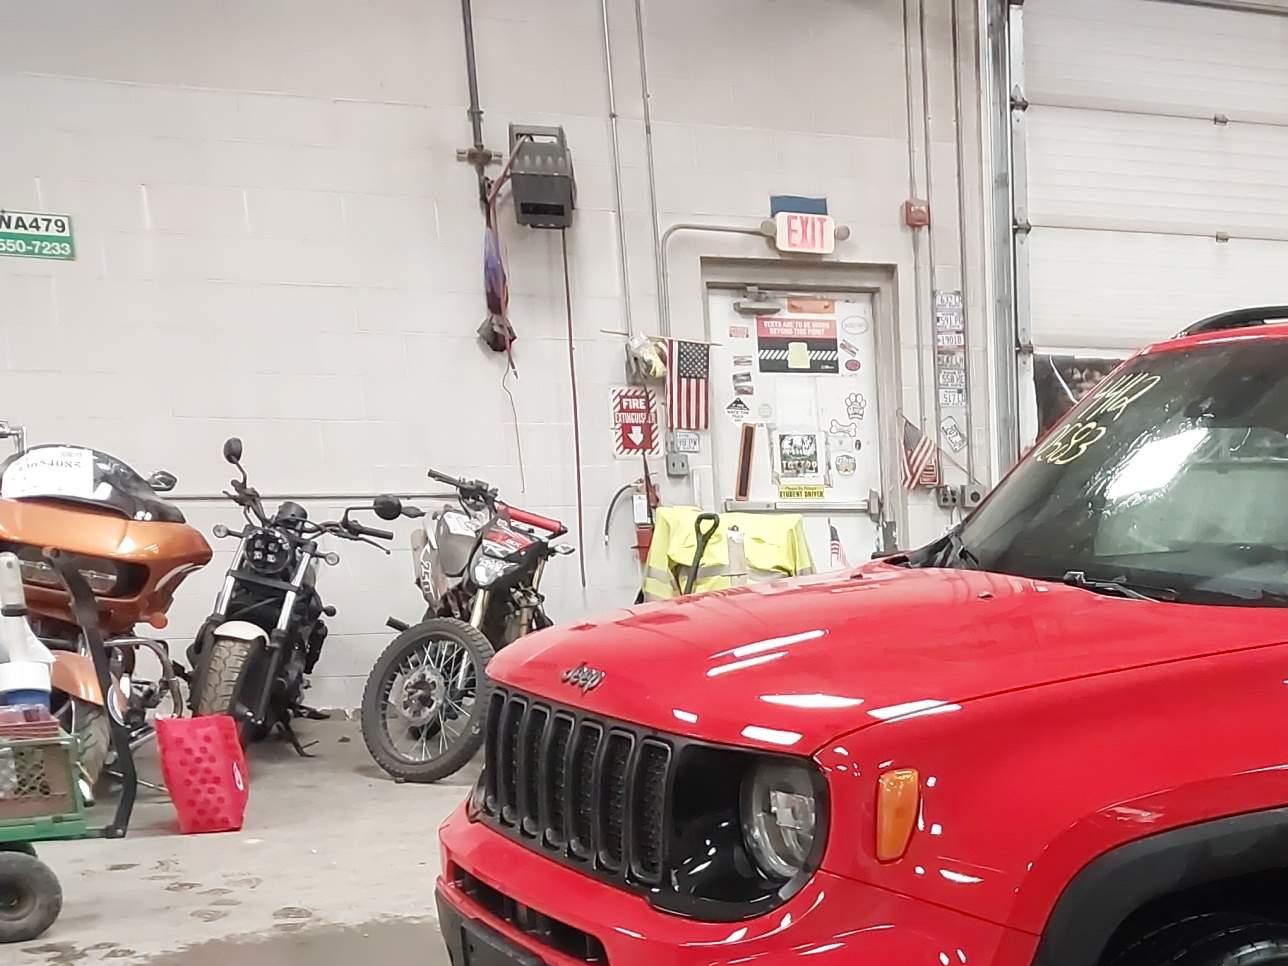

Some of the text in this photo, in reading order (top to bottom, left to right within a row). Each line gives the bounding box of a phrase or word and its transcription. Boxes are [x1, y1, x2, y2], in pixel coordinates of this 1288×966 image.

[786, 215, 828, 249] EXIT
[622, 398, 646, 410] FIRE
[779, 490, 824, 498] STUDENT DRIVER
[560, 662, 607, 697] Jeep
